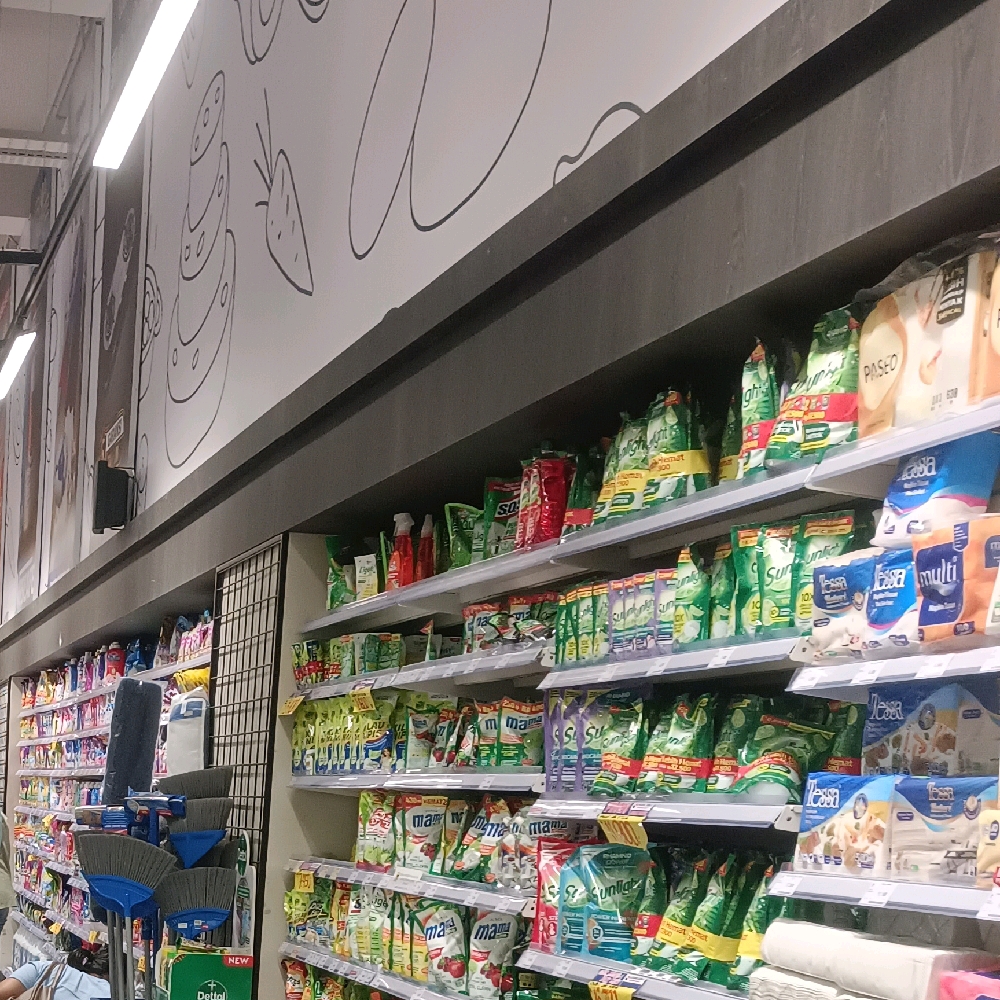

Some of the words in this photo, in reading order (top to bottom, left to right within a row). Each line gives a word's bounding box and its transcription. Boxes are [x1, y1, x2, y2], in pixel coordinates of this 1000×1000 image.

[864, 354, 898, 383] PASEO
[920, 556, 958, 588] multi
[869, 693, 904, 720] Tessa
[506, 716, 542, 730] mama
[806, 778, 841, 808] Tessa
[529, 820, 568, 835] mama
[592, 877, 642, 900] Sunlight
[426, 917, 455, 940] mama
[474, 921, 510, 940] mama
[228, 957, 249, 965] NEW
